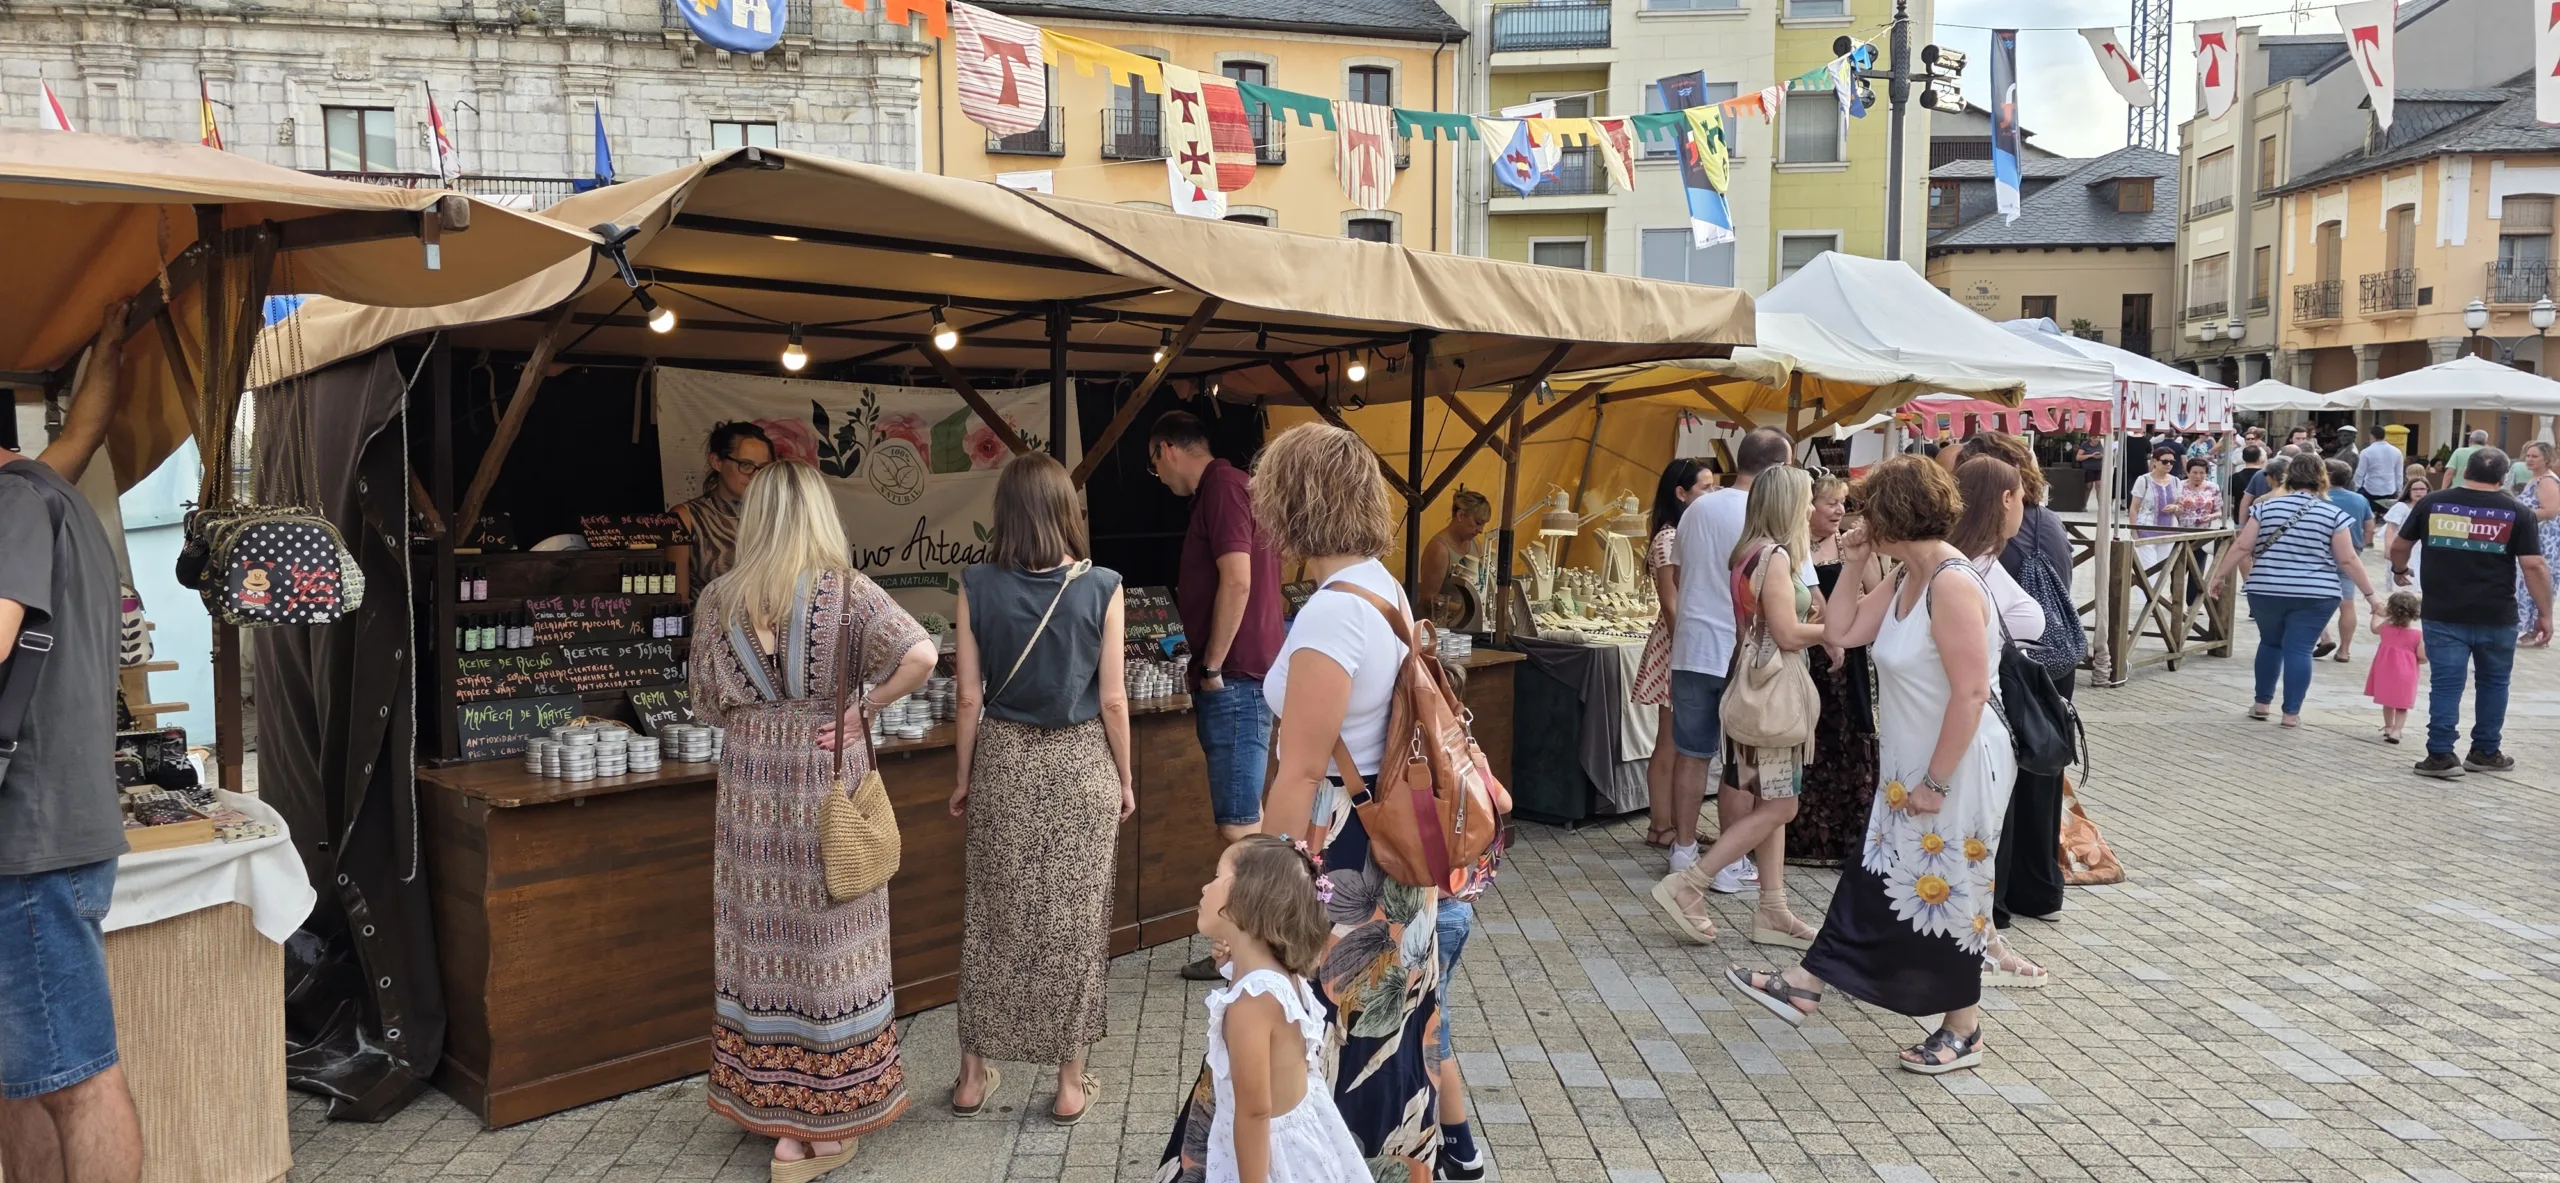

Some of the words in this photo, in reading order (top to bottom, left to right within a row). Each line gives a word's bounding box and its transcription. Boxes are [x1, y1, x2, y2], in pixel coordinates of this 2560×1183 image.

[891, 448, 911, 463] 100%
[880, 486, 922, 503] NATURAL
[2436, 504, 2512, 519] TOMMY
[2436, 517, 2502, 541] tommy
[477, 531, 507, 546] 10€
[2431, 538, 2506, 552] JEANS
[851, 543, 896, 572] ino
[875, 578, 897, 588] TICA
[901, 575, 940, 586] NATURAL
[526, 597, 564, 618] ACEITE
[572, 599, 586, 612] DE
[534, 618, 579, 632] RELAJANTE
[582, 619, 625, 633] MUSCULAR
[563, 647, 610, 665] ACEITE
[619, 646, 632, 657] DE
[634, 643, 675, 662] JOJOBA
[458, 657, 492, 676] ACEITE
[499, 657, 512, 669] DE
[516, 652, 553, 676] RICINO
[567, 663, 615, 675] CICATRICES
[569, 675, 606, 684] MANCHAS
[625, 670, 637, 678] LA
[640, 668, 660, 676] PIEL
[534, 683, 560, 696] 15€
[633, 691, 669, 709] CREMA
[674, 689, 690, 702] DE
[464, 705, 515, 731] MANTECA
[520, 709, 532, 722] DE
[535, 703, 574, 729] KARITÉ
[645, 710, 678, 729] ACEITE
[466, 733, 531, 748] ANTIOXIDANTE
[468, 749, 487, 760] PIEL
